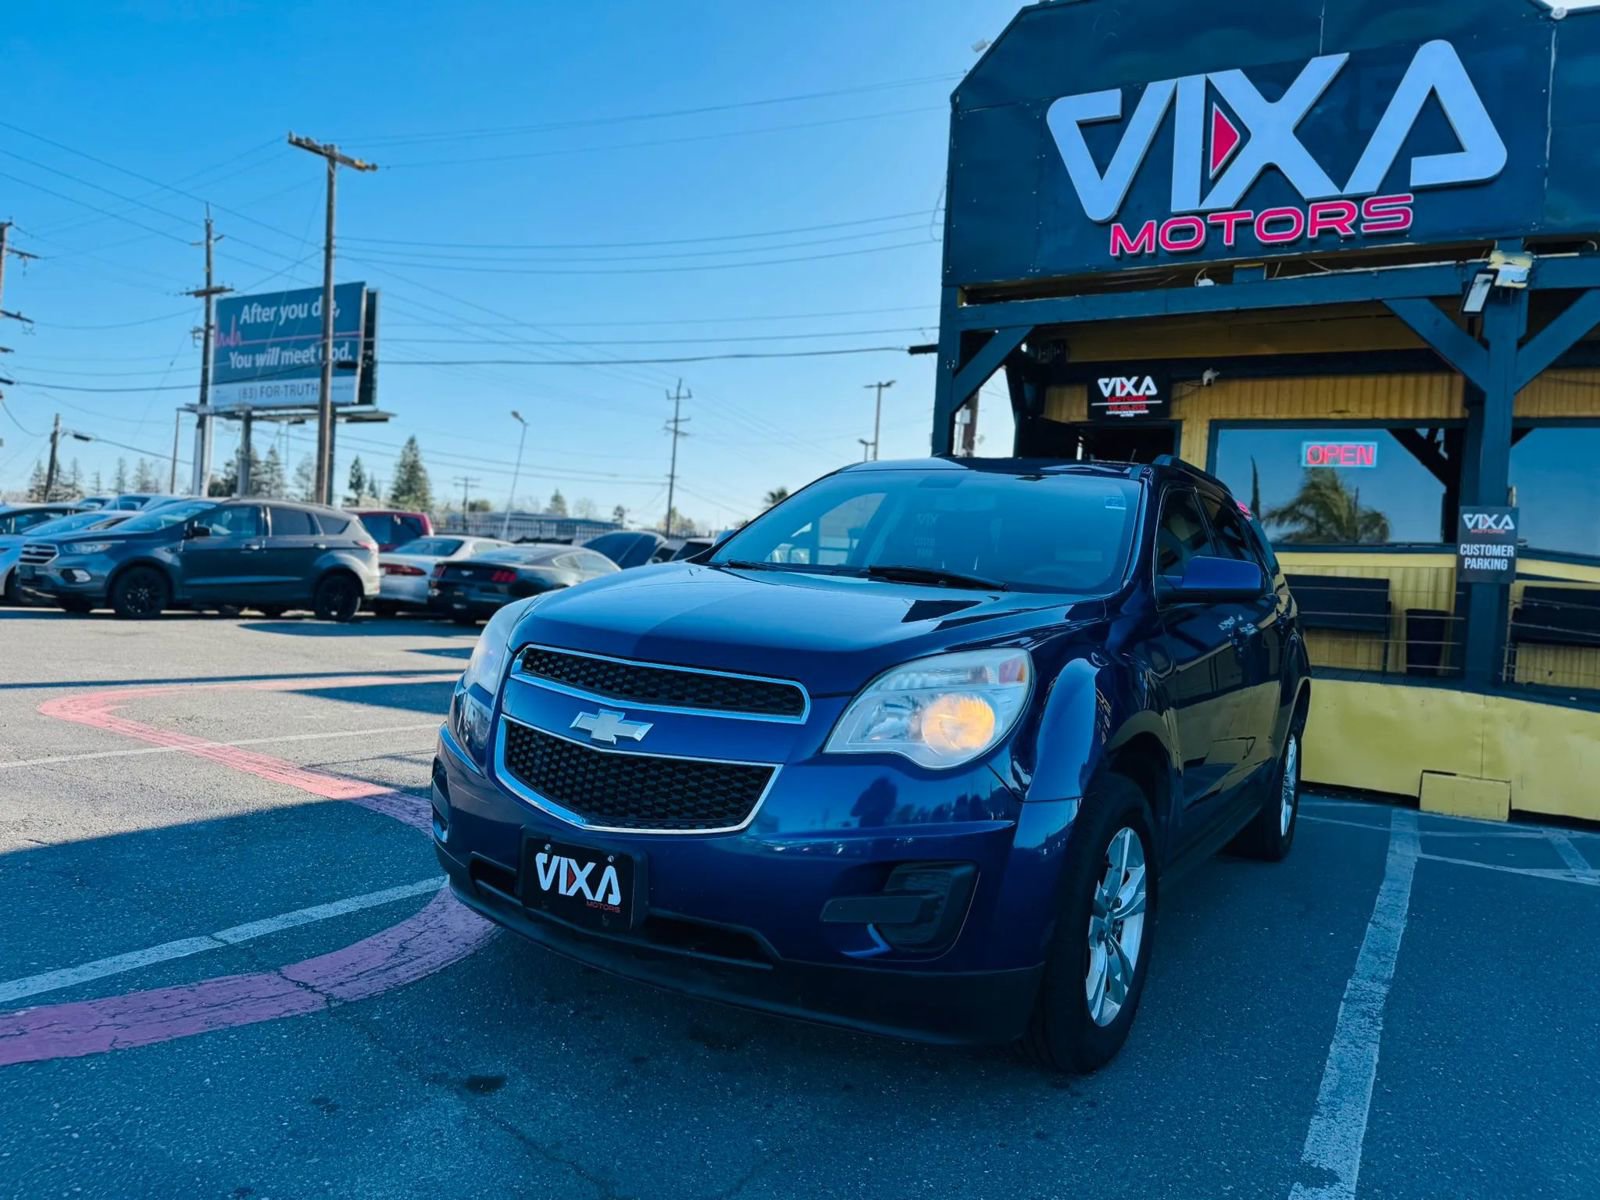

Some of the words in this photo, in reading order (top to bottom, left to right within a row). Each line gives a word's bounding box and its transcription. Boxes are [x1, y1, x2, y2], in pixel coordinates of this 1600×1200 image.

[1046, 39, 1507, 222] VIXA
[1109, 193, 1414, 257] MOTORS
[240, 302, 277, 325] After
[279, 302, 309, 326] you
[229, 351, 253, 369] You
[255, 346, 280, 367] will
[281, 343, 317, 365] meet
[1097, 375, 1158, 397] VIXA
[1307, 444, 1374, 466] OPEN
[1462, 513, 1516, 530] VIXA
[1459, 544, 1515, 557] CUSTOMER
[1463, 557, 1508, 571] PARKING
[535, 852, 621, 906] VIXA
[585, 901, 621, 914] MOTORS
